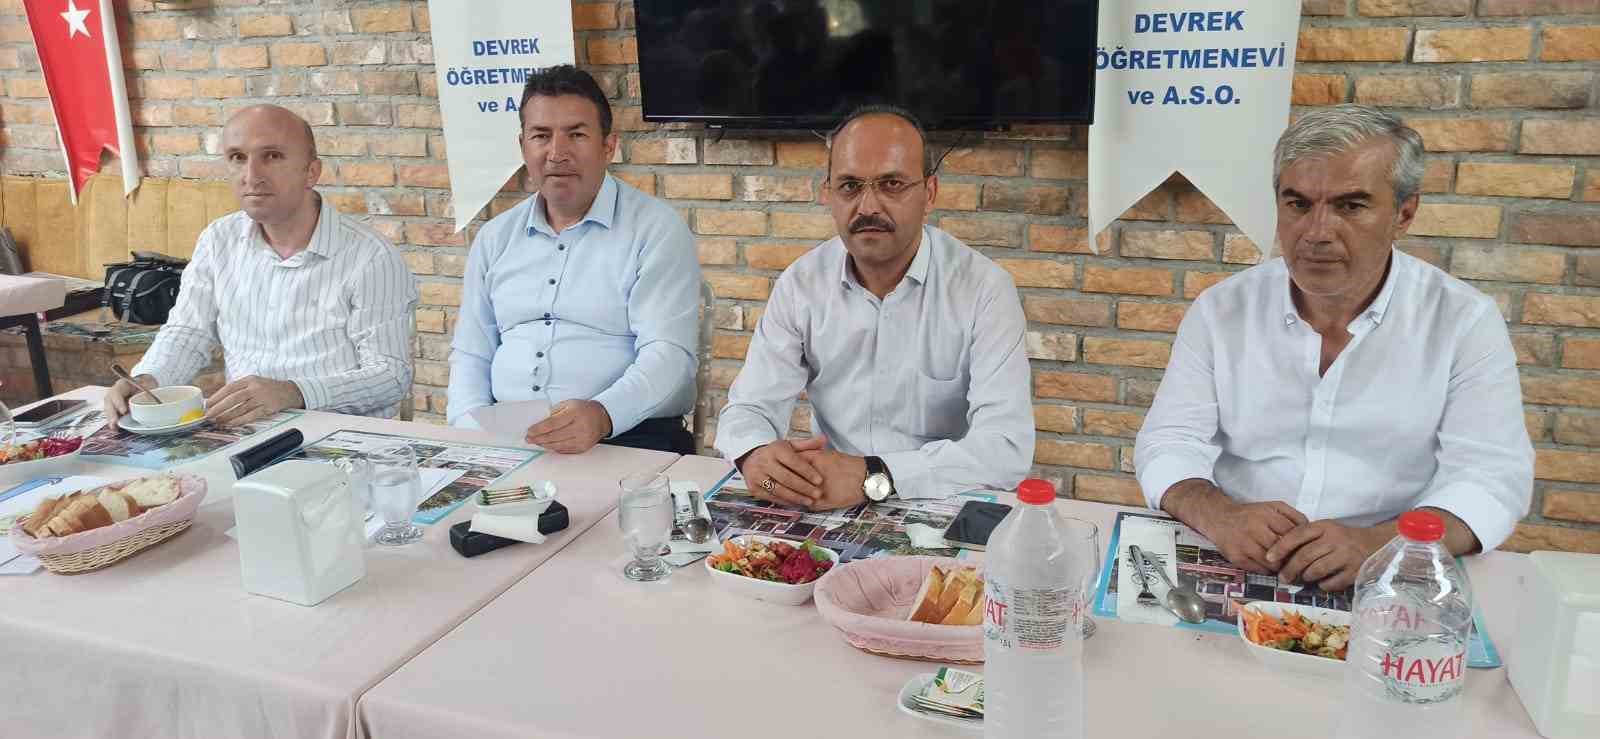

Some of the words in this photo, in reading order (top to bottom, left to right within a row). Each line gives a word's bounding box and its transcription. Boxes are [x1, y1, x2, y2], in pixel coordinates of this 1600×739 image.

[1134, 10, 1245, 33] DEVREK
[472, 38, 540, 56] DEVREK
[1095, 42, 1286, 70] ÖĞRETMENEVİ
[1127, 90, 1154, 105] ve
[1162, 85, 1241, 105] A.S.O.
[477, 101, 499, 113] ve
[1381, 651, 1465, 684] HAYAT
